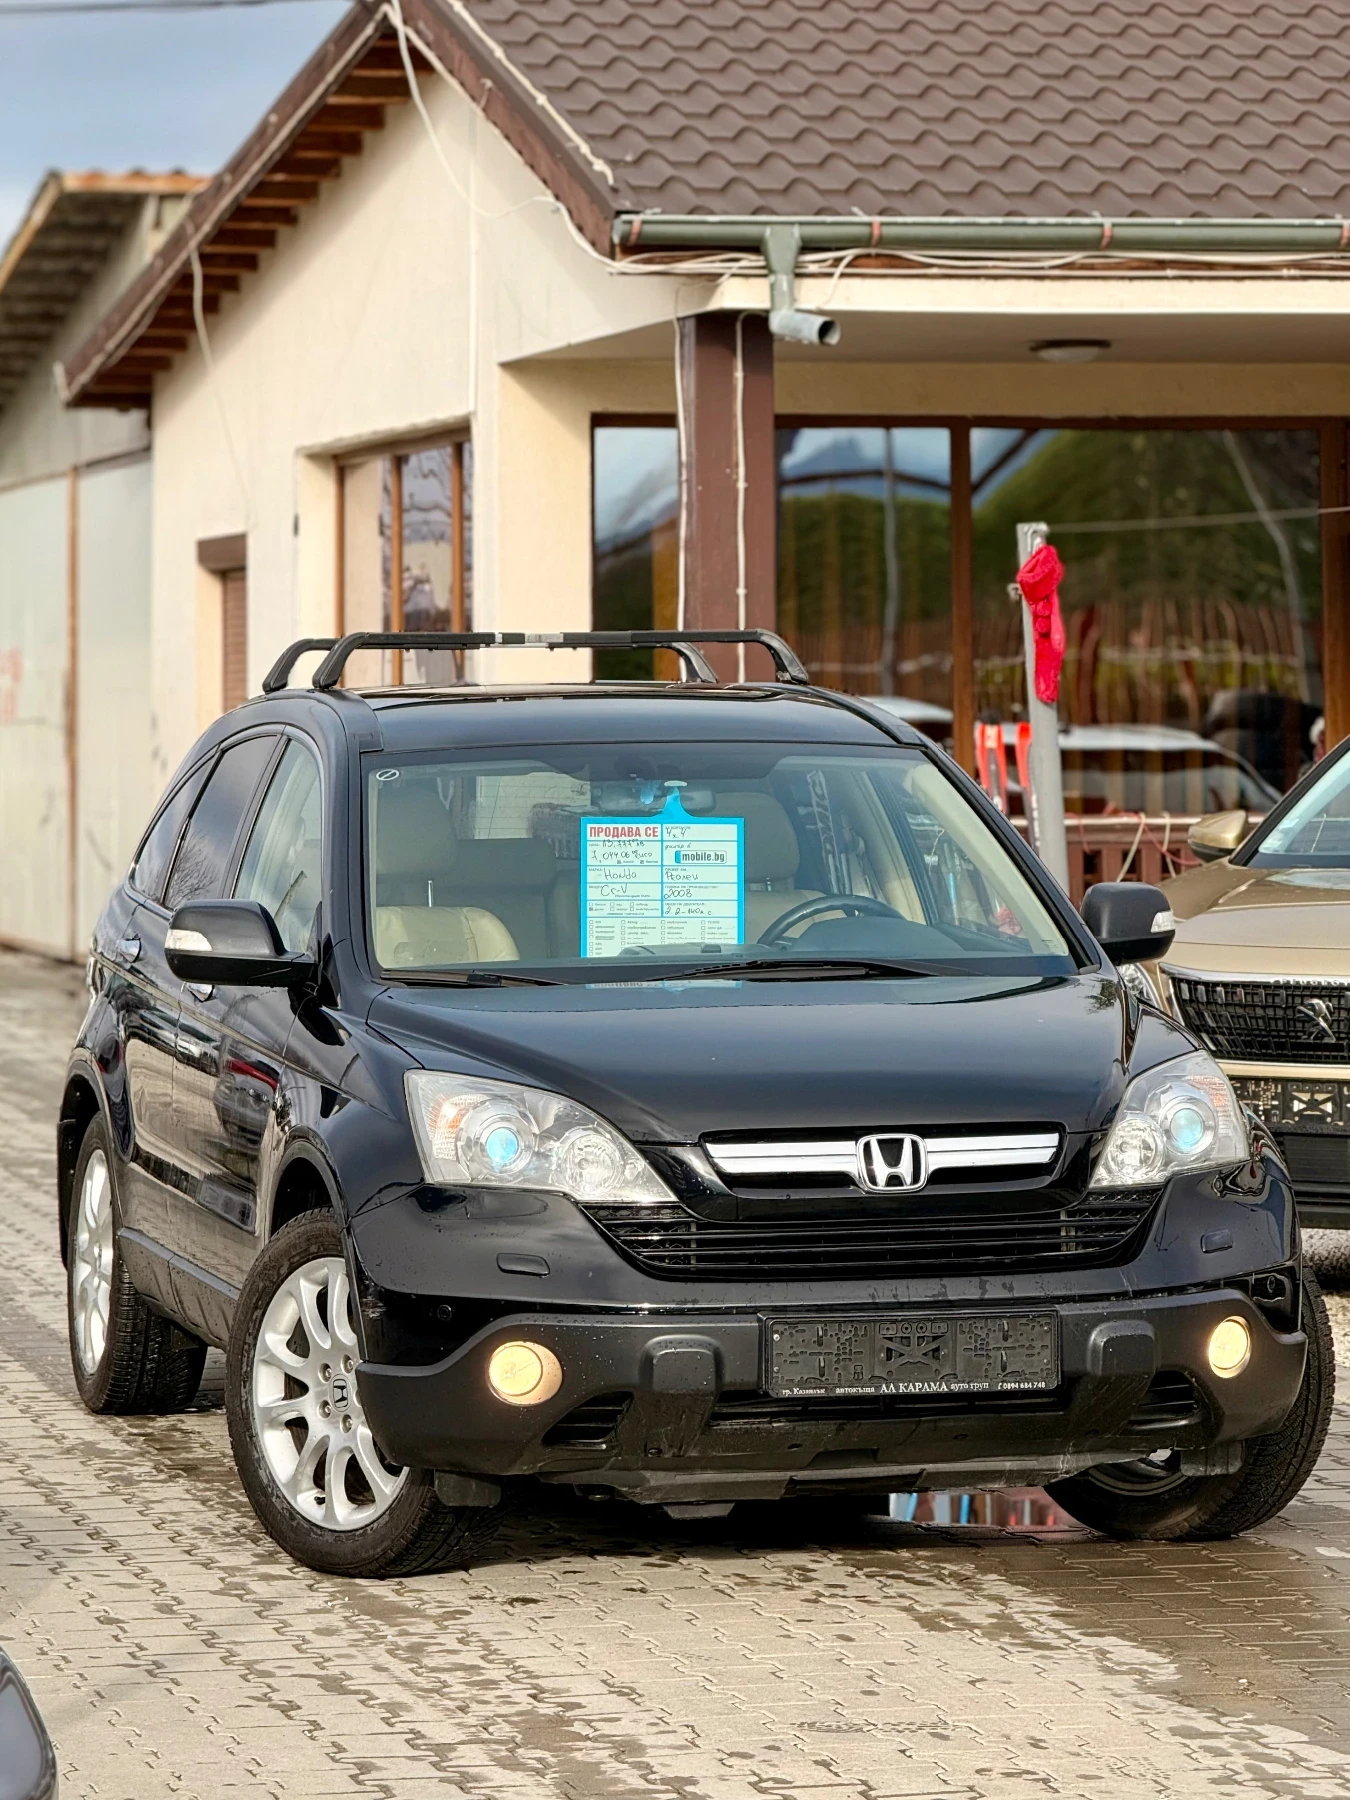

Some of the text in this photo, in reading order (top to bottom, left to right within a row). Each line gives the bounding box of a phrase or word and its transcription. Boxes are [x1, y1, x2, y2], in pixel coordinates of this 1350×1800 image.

[589, 826, 659, 839] ПРОДАВА СЕ
[682, 852, 725, 862] mobile.bg
